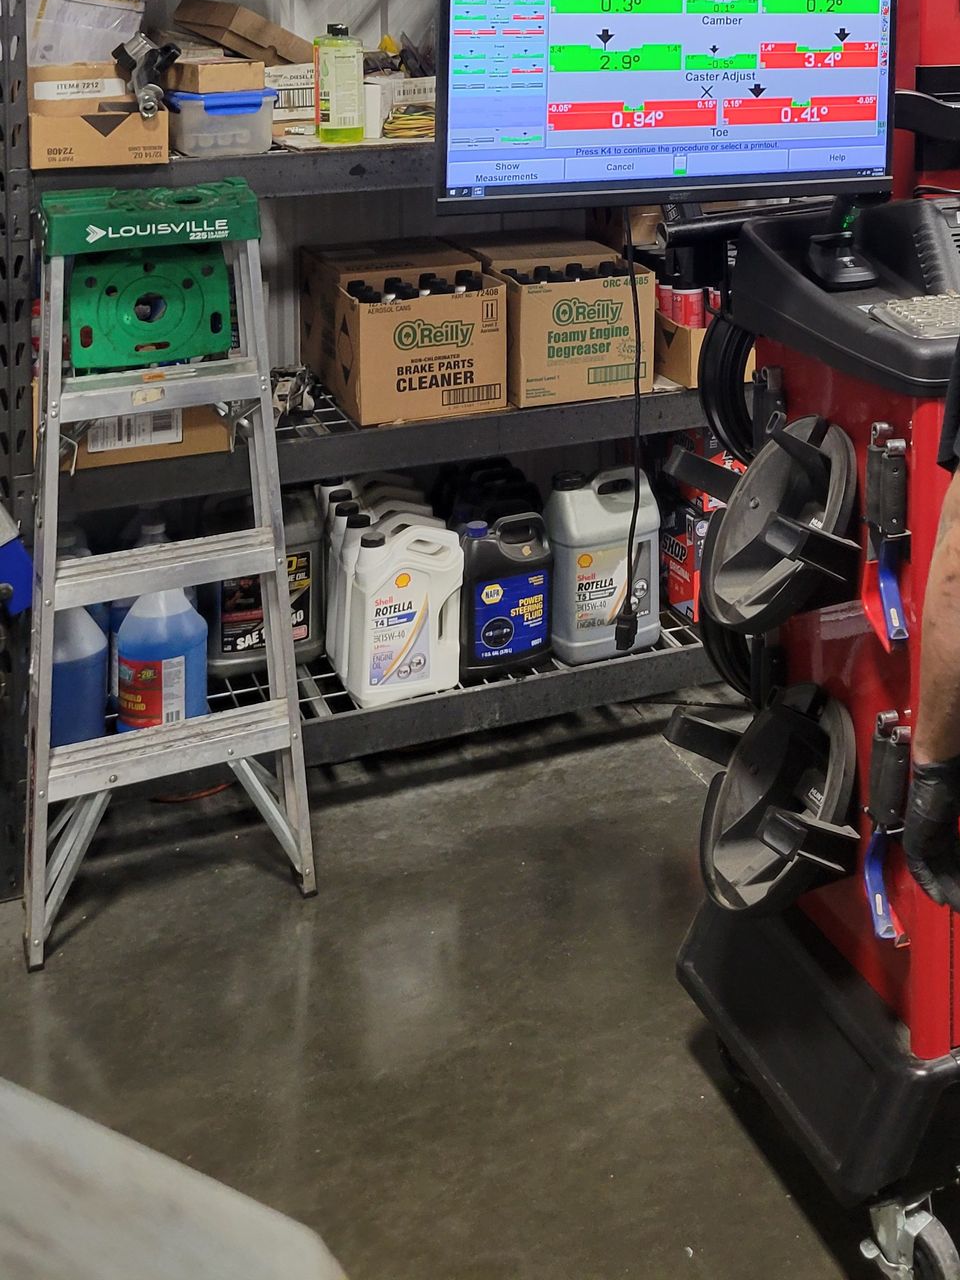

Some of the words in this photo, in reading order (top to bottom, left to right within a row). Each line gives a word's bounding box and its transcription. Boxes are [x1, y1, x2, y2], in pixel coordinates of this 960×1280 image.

[702, 16, 743, 25] Camber
[599, 55, 640, 70] 2.9°
[804, 52, 842, 67] 3.4°
[685, 72, 720, 81] Caster
[722, 72, 756, 82] Adjust
[549, 104, 572, 112] -0.05°
[856, 96, 876, 104] -0.05°
[611, 111, 663, 128] 0.94°
[780, 106, 828, 122] 0.41°
[711, 128, 728, 137] Toe
[576, 148, 598, 156] Press
[623, 146, 656, 154] continue
[671, 143, 709, 153] procedure
[750, 141, 779, 151] printout.
[829, 153, 846, 162] Help
[606, 163, 634, 171] Cancel
[475, 173, 538, 183] Measurements
[108, 219, 228, 238] LOUISVILLE
[189, 232, 207, 240] 225
[602, 279, 621, 289] ORC
[476, 288, 499, 297] 72408
[555, 300, 619, 324] O'Reilly
[396, 321, 473, 348] O'Reilly
[547, 329, 587, 344] Foamy
[589, 324, 629, 340] Engine
[547, 341, 611, 358] Degreaser
[410, 353, 460, 363] NON-CHLORINATED
[397, 363, 434, 376] BRAKE
[438, 358, 474, 371] PARTS
[396, 371, 474, 393] CLEANER
[662, 535, 687, 562] SHOP
[295, 572, 307, 580] OIL
[577, 573, 596, 581] Shell
[577, 578, 614, 592] ROTELLA
[485, 589, 500, 599] NAPA
[374, 596, 393, 607] Shell
[519, 594, 543, 607] POWER
[584, 600, 607, 611] 15W-40
[375, 601, 413, 617] ROTELLA
[510, 601, 543, 617] STEERING
[524, 609, 543, 621] FLUID
[375, 619, 385, 628] T4
[236, 631, 260, 650] SAE
[381, 629, 406, 642] 15W-40
[372, 652, 393, 662] ENGINE
[372, 662, 381, 670] OIL
